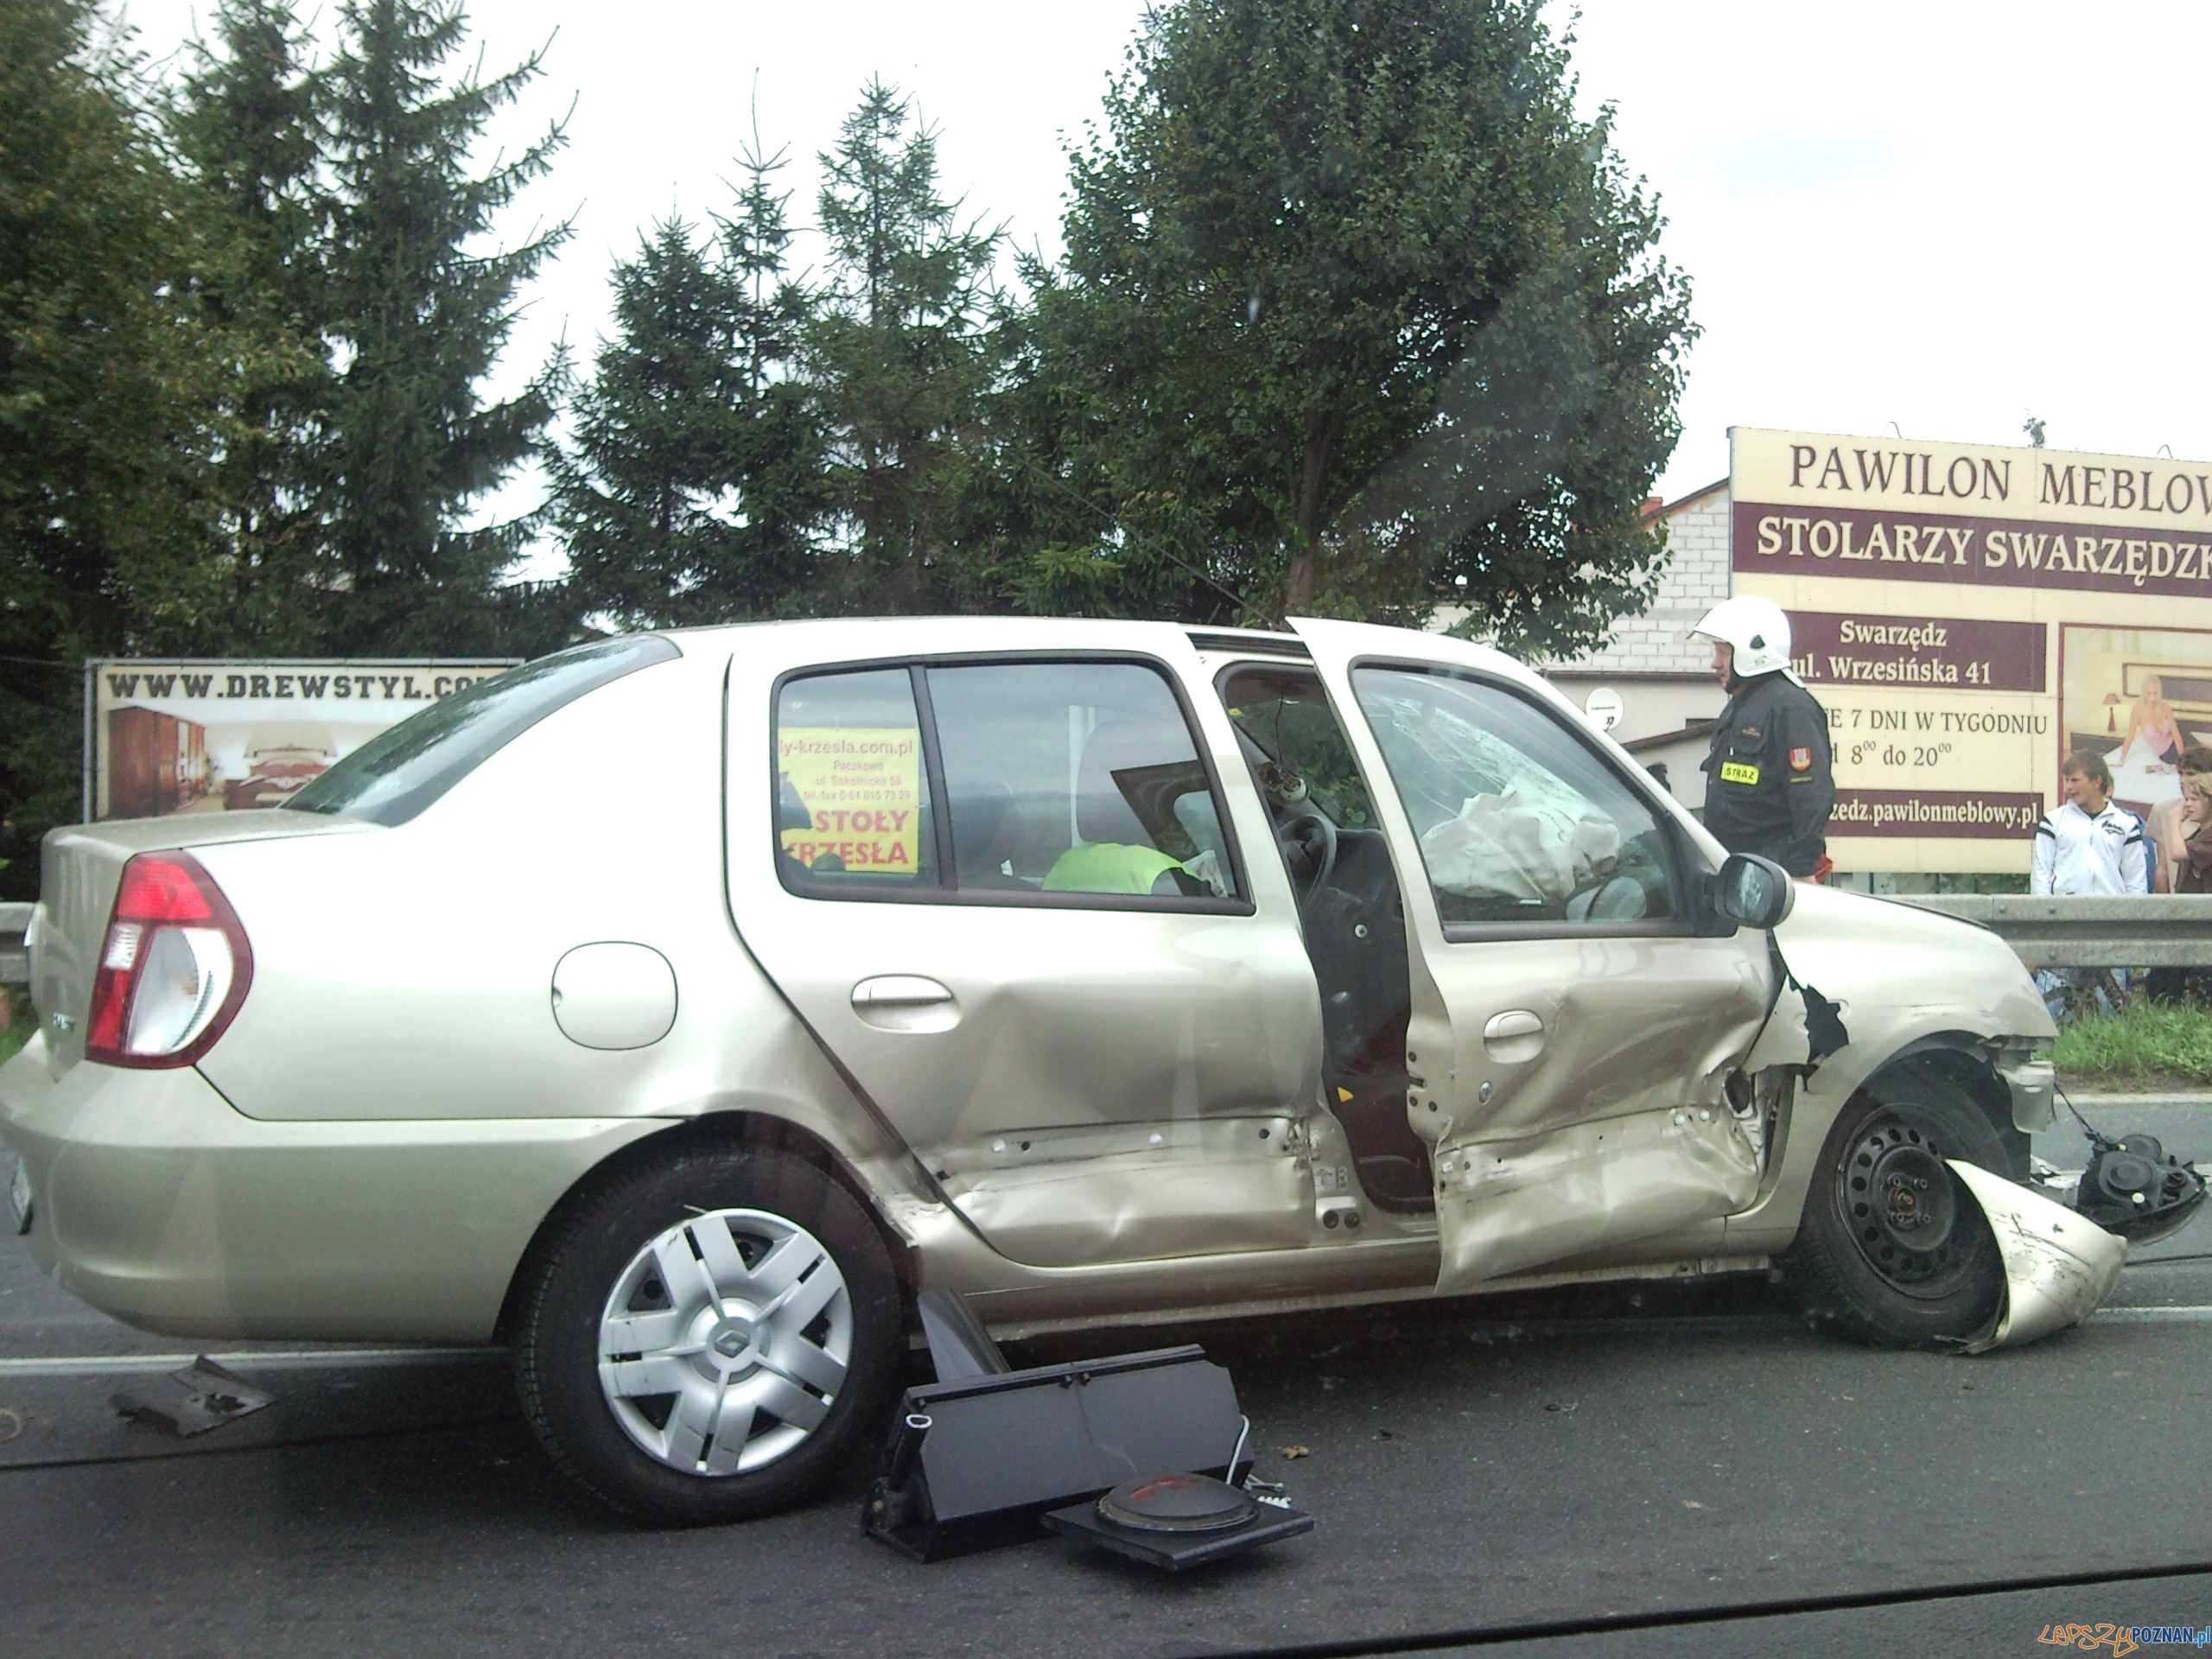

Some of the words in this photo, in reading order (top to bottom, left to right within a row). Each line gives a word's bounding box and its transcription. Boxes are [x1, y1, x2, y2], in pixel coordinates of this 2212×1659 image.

[1789, 444, 2012, 501] PAWILON
[1758, 515, 1974, 566] STOLARZY
[1840, 620, 1947, 652] Swarzędz
[1791, 652, 1821, 678] ul.
[1828, 655, 1958, 683] Wrzesińska
[1965, 661, 1991, 684] 41
[106, 673, 485, 699] WWW.DREWSTYL.CO
[1851, 709, 1862, 728] 7
[1870, 709, 1906, 730] DNI
[1914, 711, 1934, 731] W
[1941, 712, 2047, 734] TYGODNIU
[1883, 745, 1906, 766] do
[816, 810, 910, 833] STOŁY
